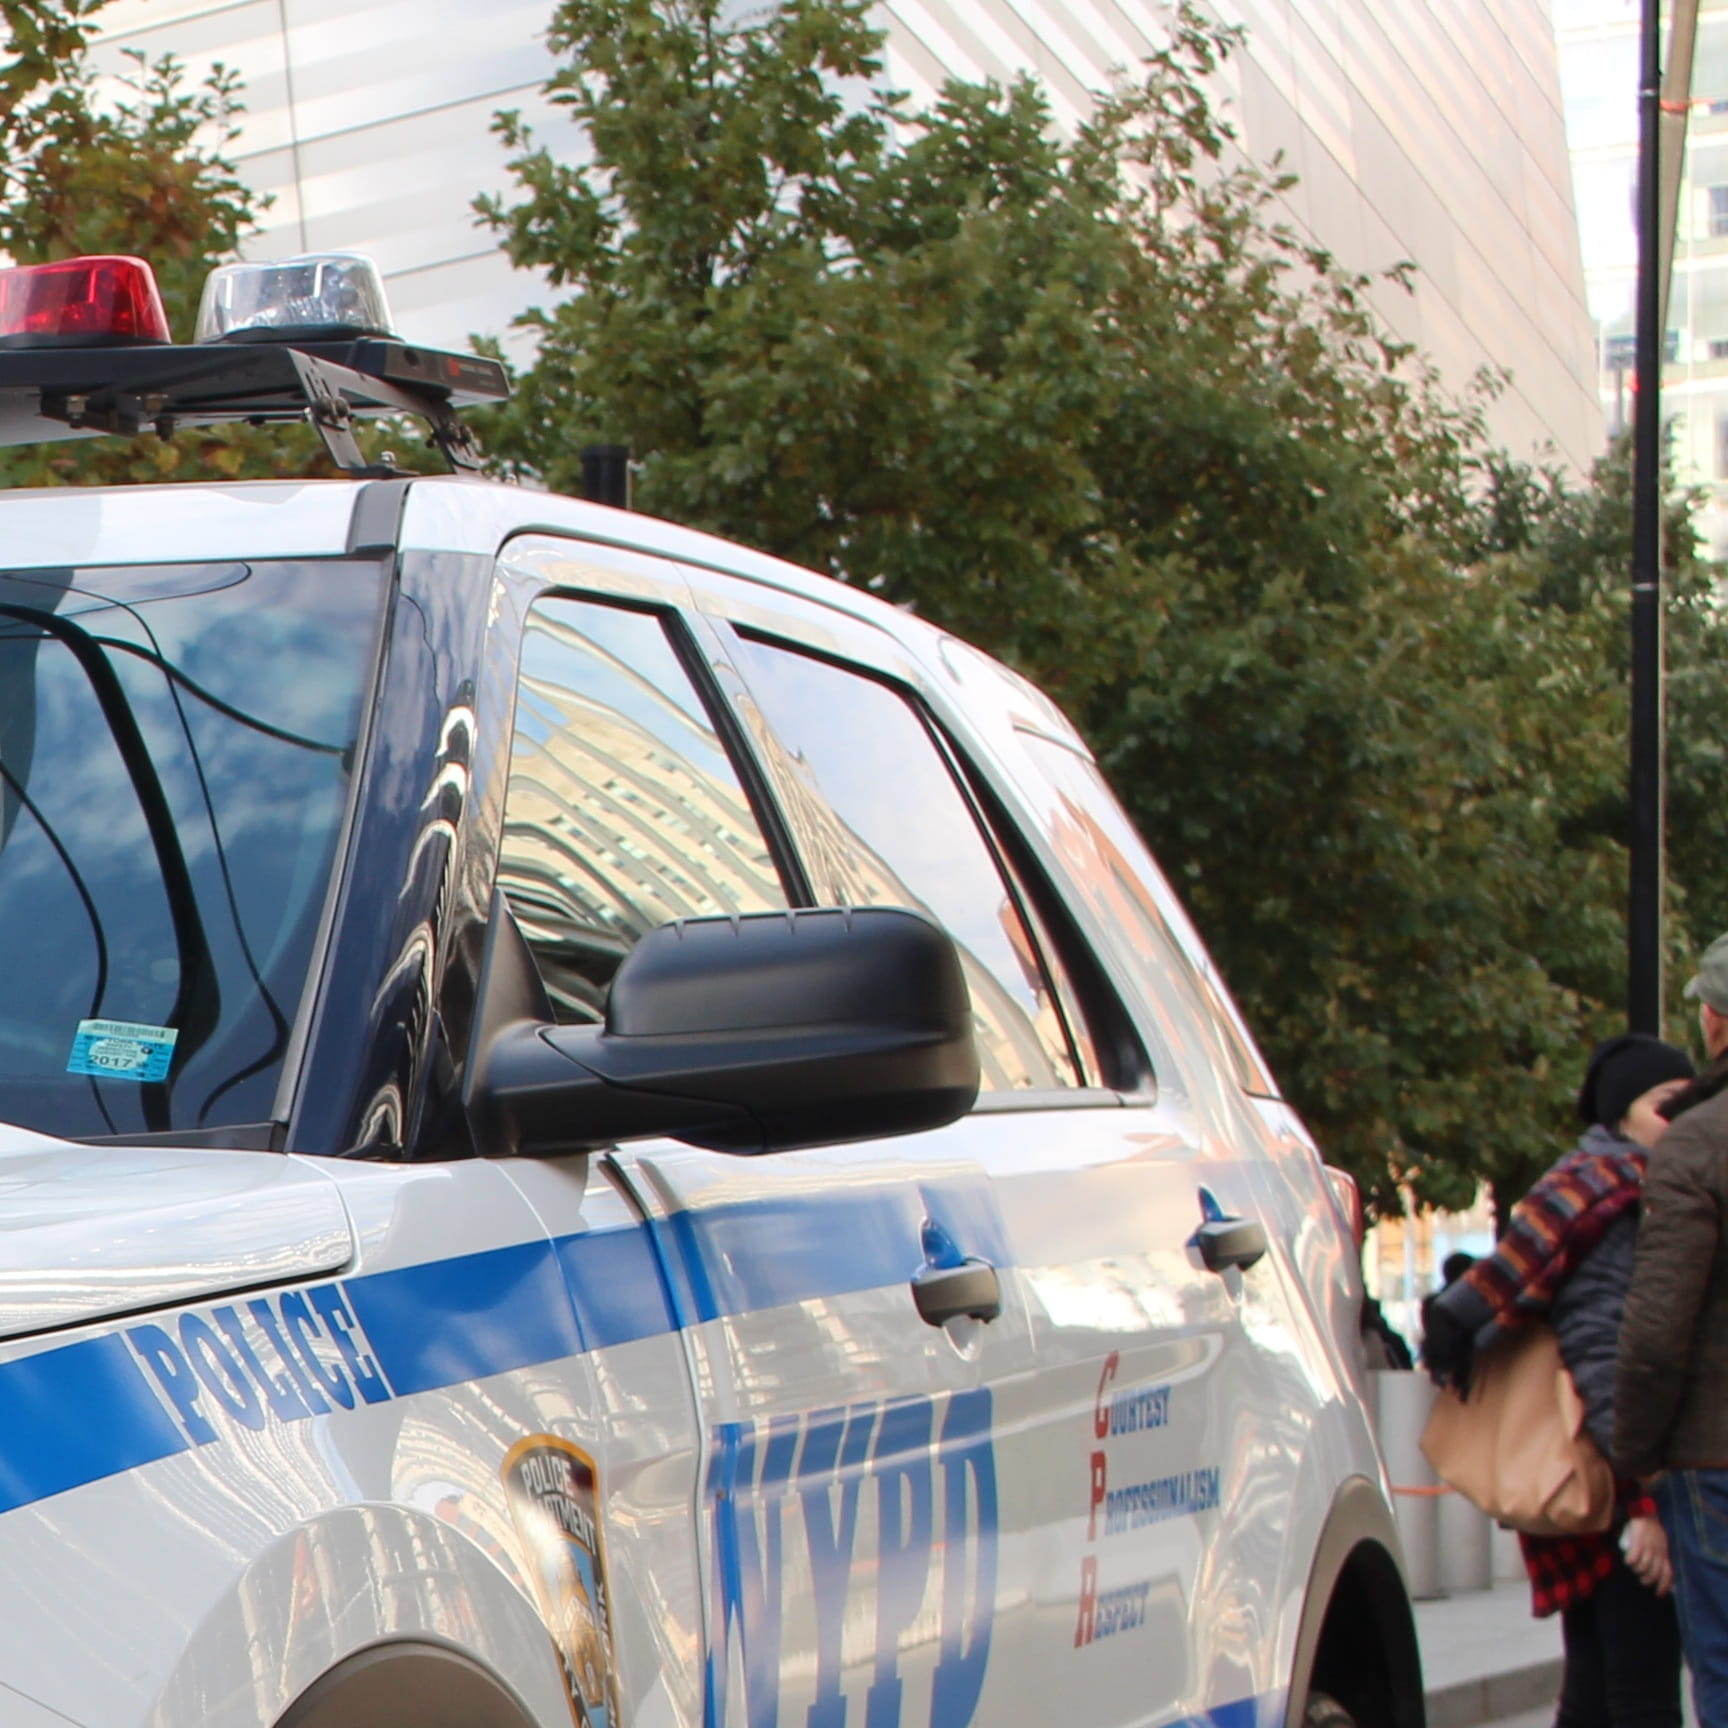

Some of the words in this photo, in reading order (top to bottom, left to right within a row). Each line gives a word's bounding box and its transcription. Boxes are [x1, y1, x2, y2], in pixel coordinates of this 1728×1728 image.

[88, 1055, 133, 1068] 2017
[126, 1282, 392, 1447] POLICE
[520, 1455, 574, 1502] POLICE
